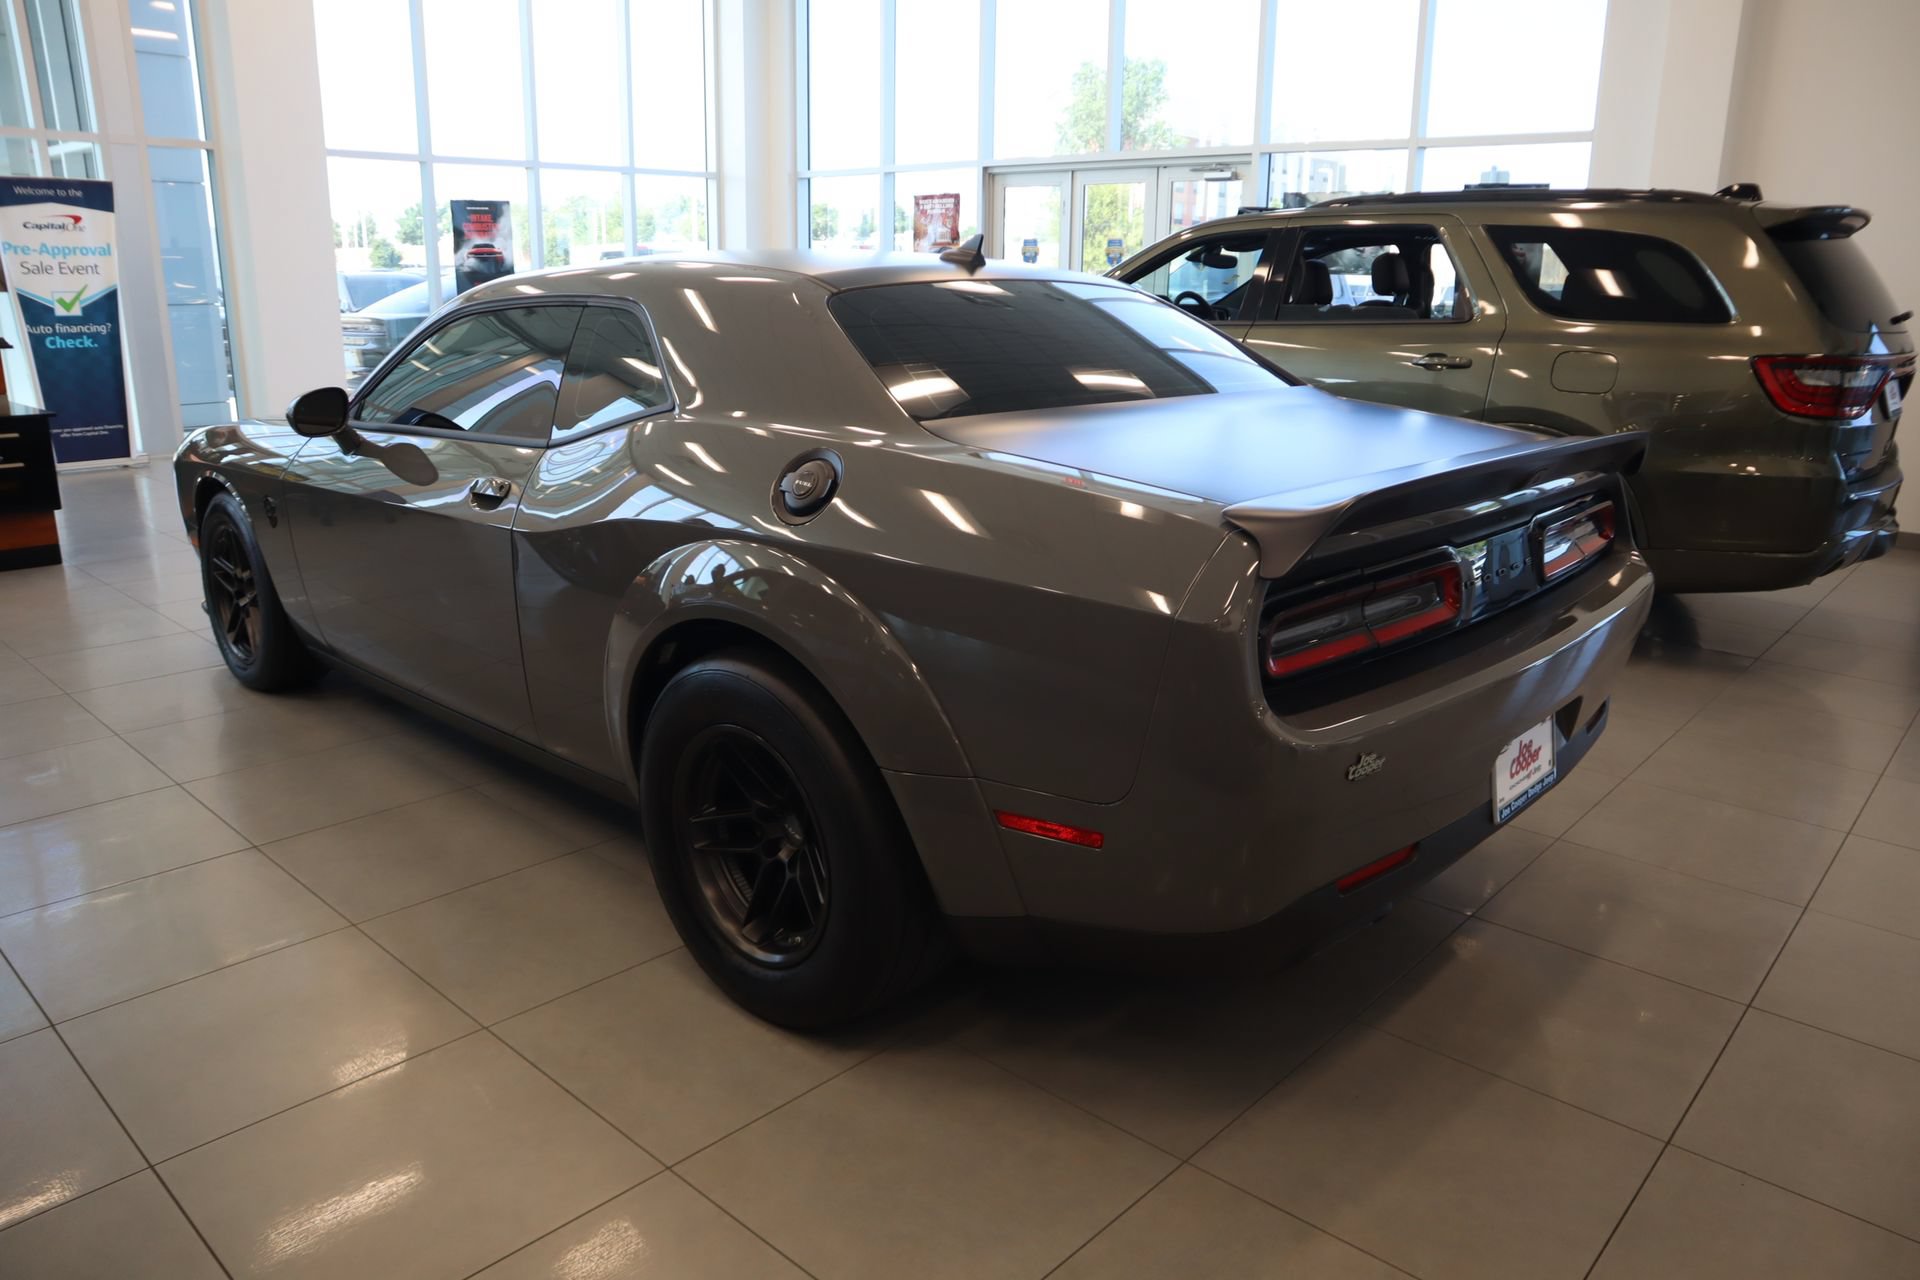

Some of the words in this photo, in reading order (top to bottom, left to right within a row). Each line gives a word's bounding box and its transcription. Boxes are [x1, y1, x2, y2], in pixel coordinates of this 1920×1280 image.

[13, 185, 55, 196] Welcome
[57, 188, 67, 197] to
[68, 188, 83, 198] the
[2, 241, 112, 259] Pre-Approval
[20, 260, 54, 275] Sale
[58, 261, 101, 275] Event
[26, 323, 53, 334] Auto
[55, 322, 112, 335] financing?
[45, 335, 98, 349] Check.
[1501, 805, 1511, 819] Joe
[1511, 793, 1528, 811] Cooper
